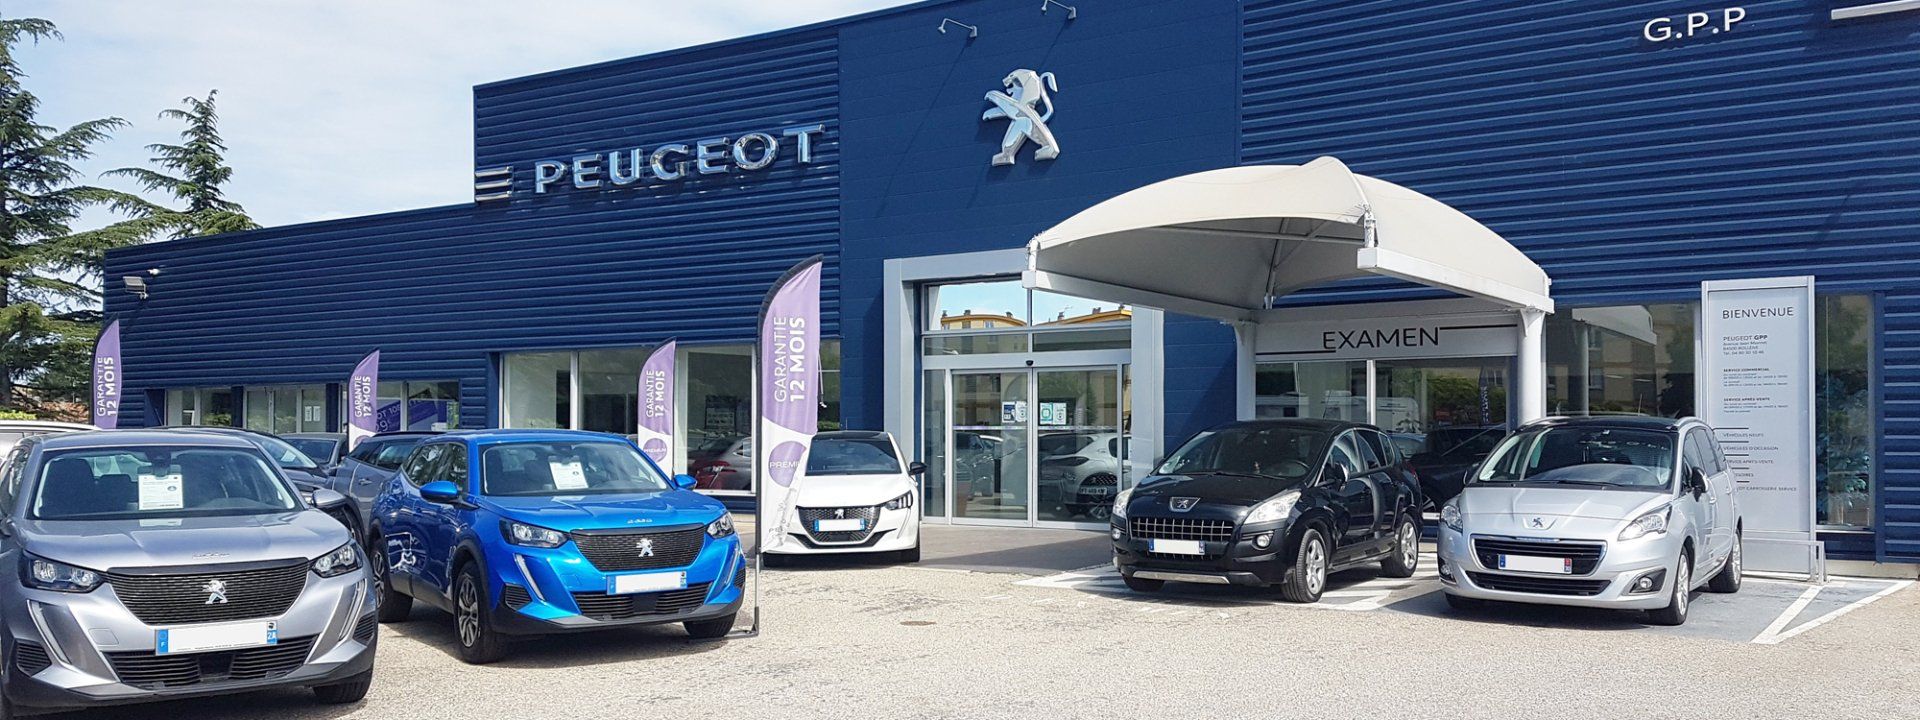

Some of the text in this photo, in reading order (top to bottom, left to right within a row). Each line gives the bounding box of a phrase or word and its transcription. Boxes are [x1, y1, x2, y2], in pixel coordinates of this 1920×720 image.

[1644, 7, 1746, 41] G.P.P
[534, 123, 826, 194] PEUGEOT
[1722, 307, 1795, 319] BIENVENUE
[774, 317, 787, 402] GARANTIE
[789, 317, 805, 402] 12 MOIS
[1322, 327, 1439, 350] EXAMEN
[97, 357, 106, 417] GARANTIE
[104, 357, 117, 416] 12 MOIS
[355, 376, 363, 418] GARANTIE
[362, 376, 372, 417] 12 MOIS
[647, 370, 655, 418] GARANTIE
[655, 371, 665, 417] 12 MOIS
